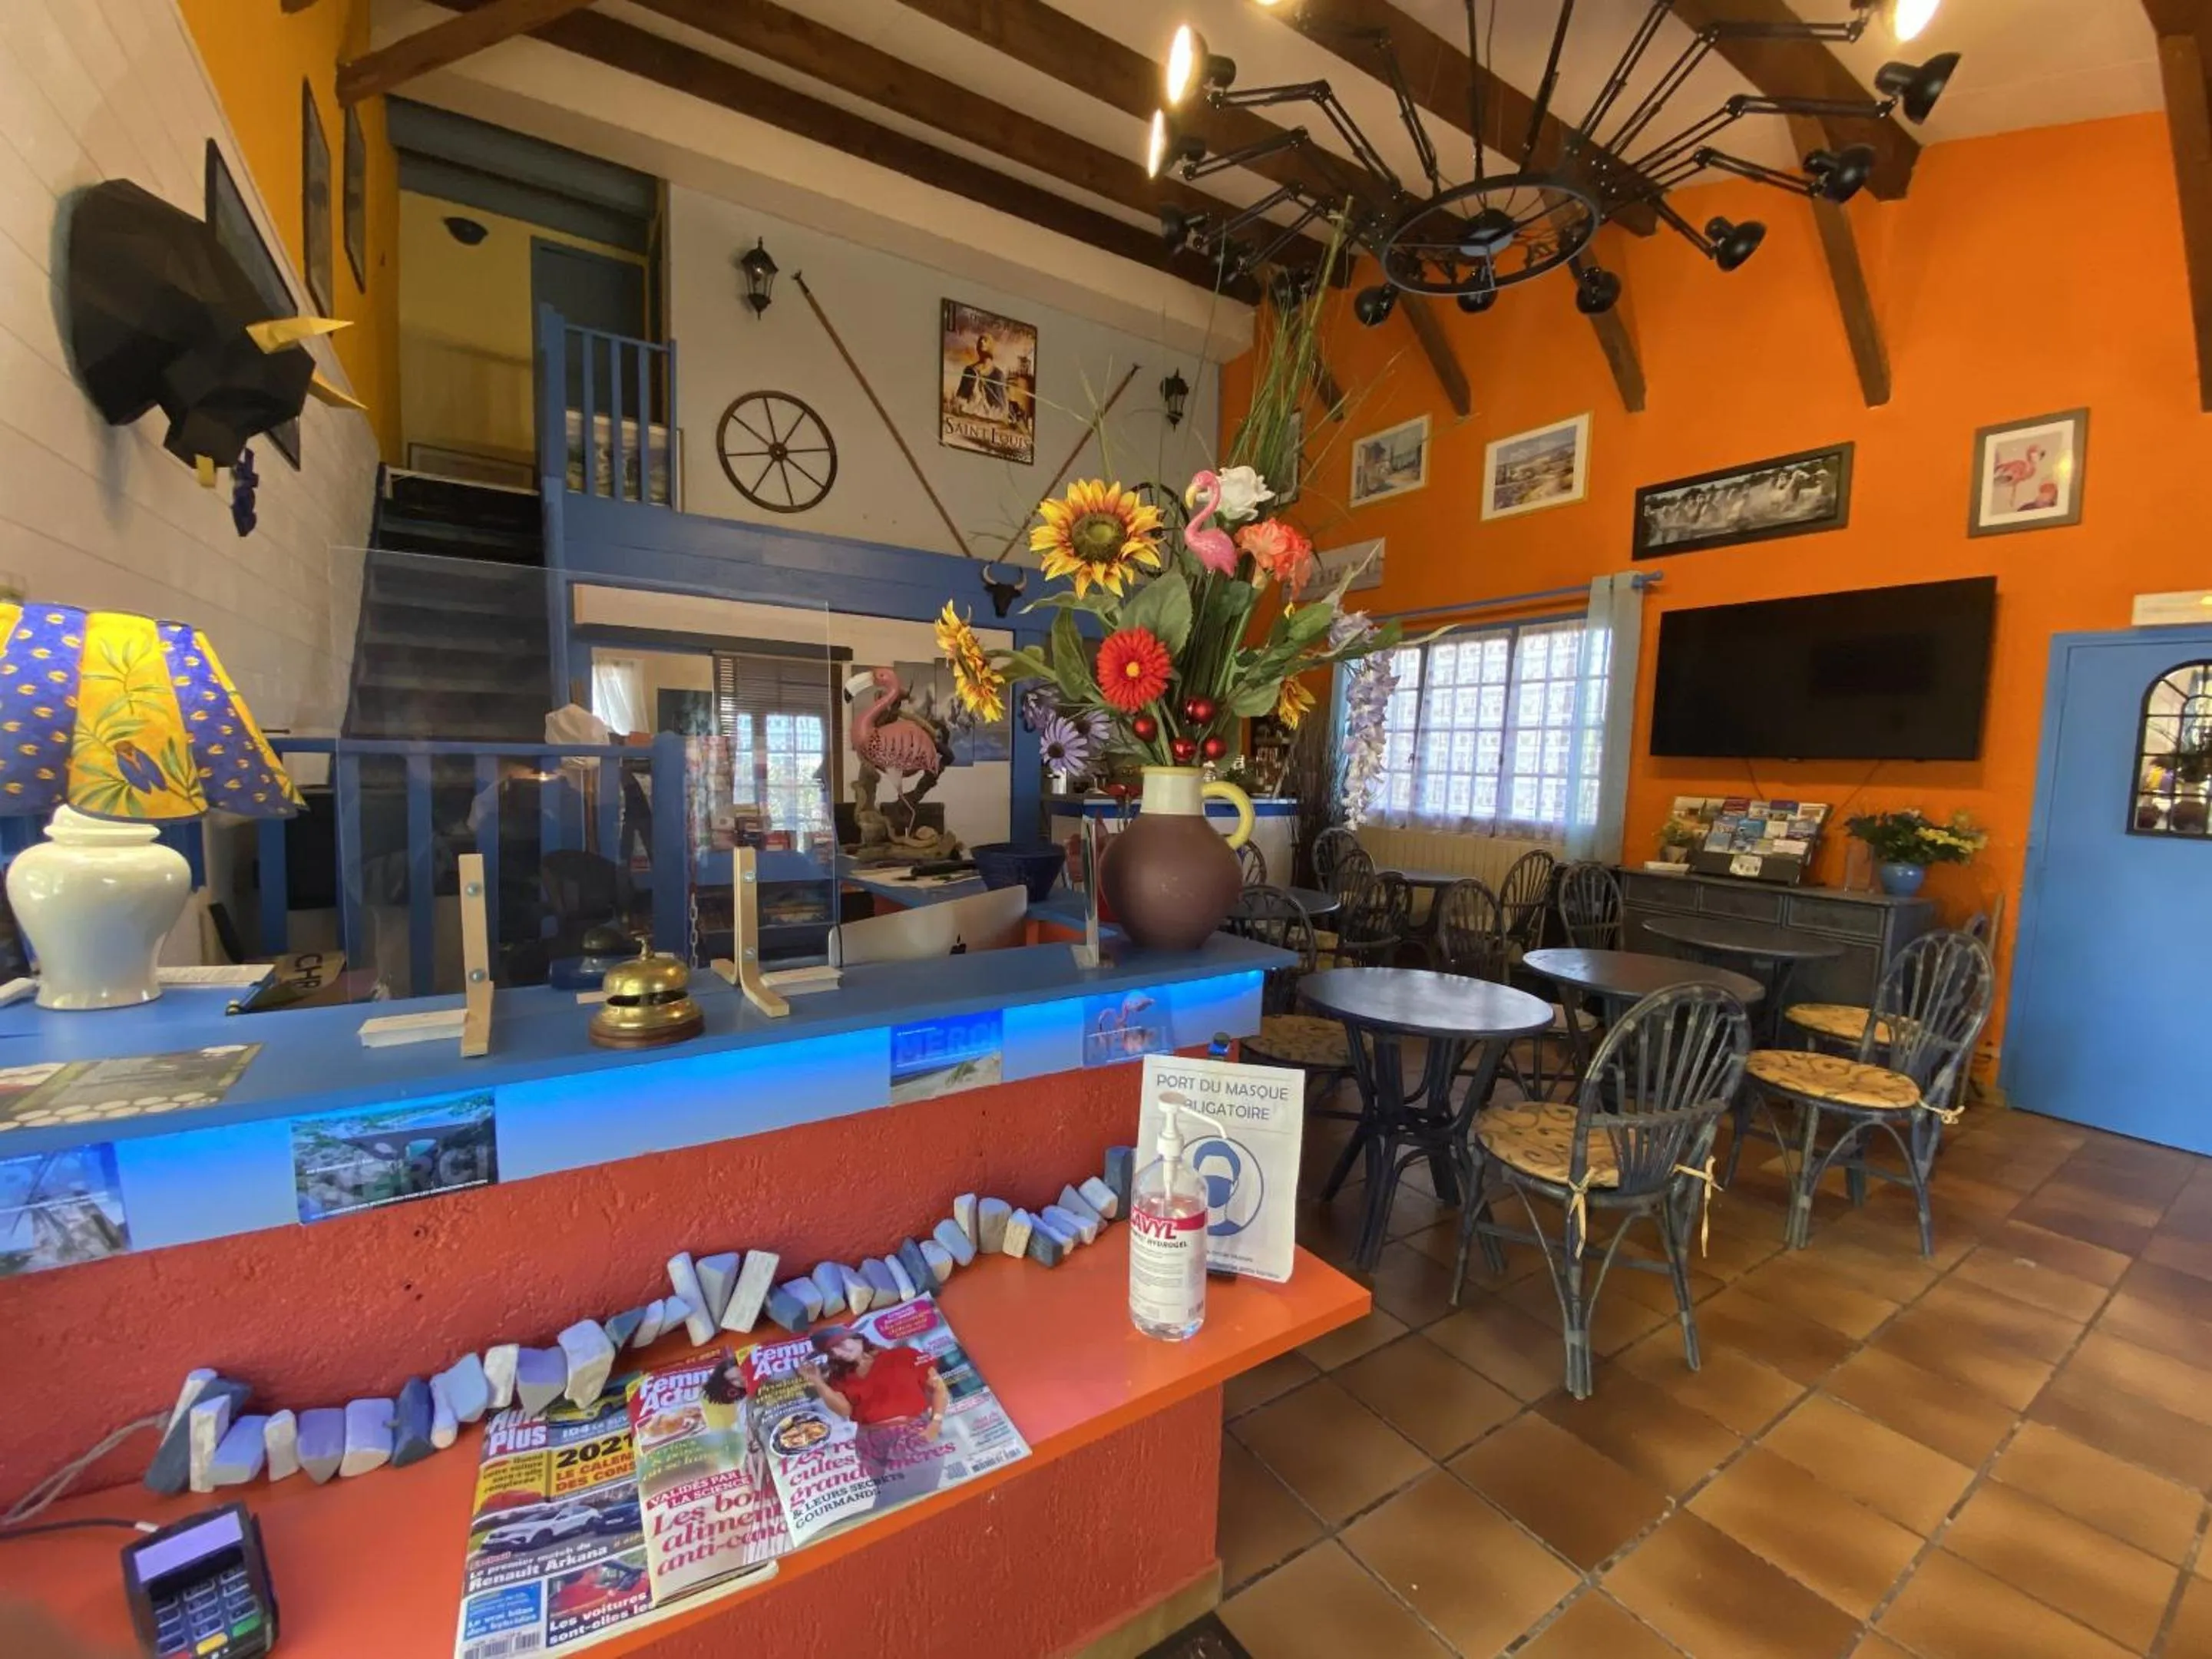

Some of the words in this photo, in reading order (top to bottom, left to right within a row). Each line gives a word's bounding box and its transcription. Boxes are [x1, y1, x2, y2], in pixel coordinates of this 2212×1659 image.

[1156, 1074, 1195, 1090] PORT
[1199, 1079, 1222, 1093] DU
[1225, 1082, 1289, 1101] MASQUE
[1184, 1098, 1271, 1121] BLIGATOIRE
[489, 1425, 547, 1456] Plus
[556, 1434, 633, 1469] 2021
[556, 1469, 576, 1482] LE
[779, 1447, 825, 1476] Les
[789, 1455, 855, 1487] cultes
[556, 1476, 589, 1492] DES
[672, 1492, 691, 1506] LA
[693, 1476, 752, 1498] SCIENCE
[712, 1471, 739, 1487] PAR
[805, 1487, 848, 1511] LEURS
[849, 1472, 905, 1493] SECRETS
[653, 1506, 706, 1536] Les
[795, 1489, 881, 1529] GOURMANDS
[469, 1565, 540, 1591] Renault
[545, 1545, 609, 1573] Arkana
[550, 1616, 577, 1633] Les
[583, 1591, 647, 1621] voitures
[550, 1608, 630, 1645] sont-elles
